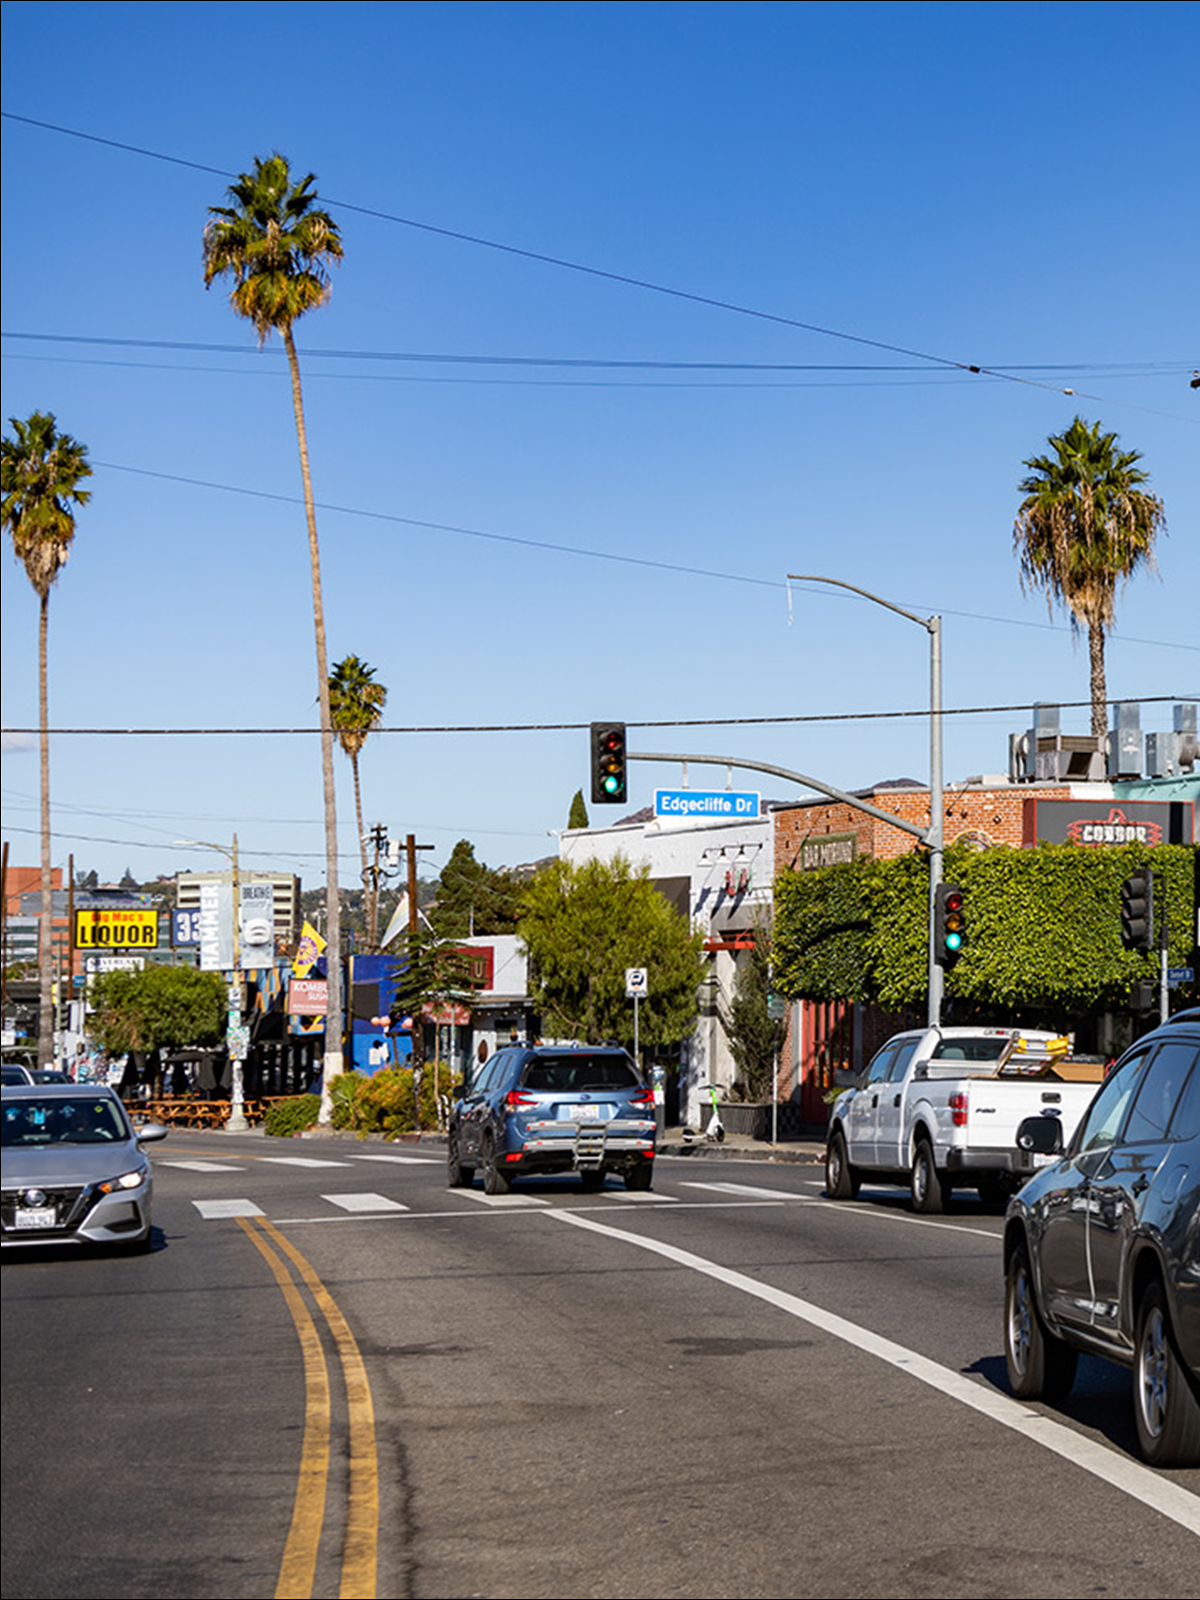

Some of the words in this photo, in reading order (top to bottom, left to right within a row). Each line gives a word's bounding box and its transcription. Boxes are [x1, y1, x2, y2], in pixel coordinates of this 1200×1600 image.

[661, 796, 732, 815] Edgecliffe
[735, 798, 753, 812] Dr
[1083, 825, 1147, 842] CONDOR
[112, 912, 144, 922] Mac's
[200, 885, 219, 967] HAMMER
[80, 924, 154, 945] LIQUOR
